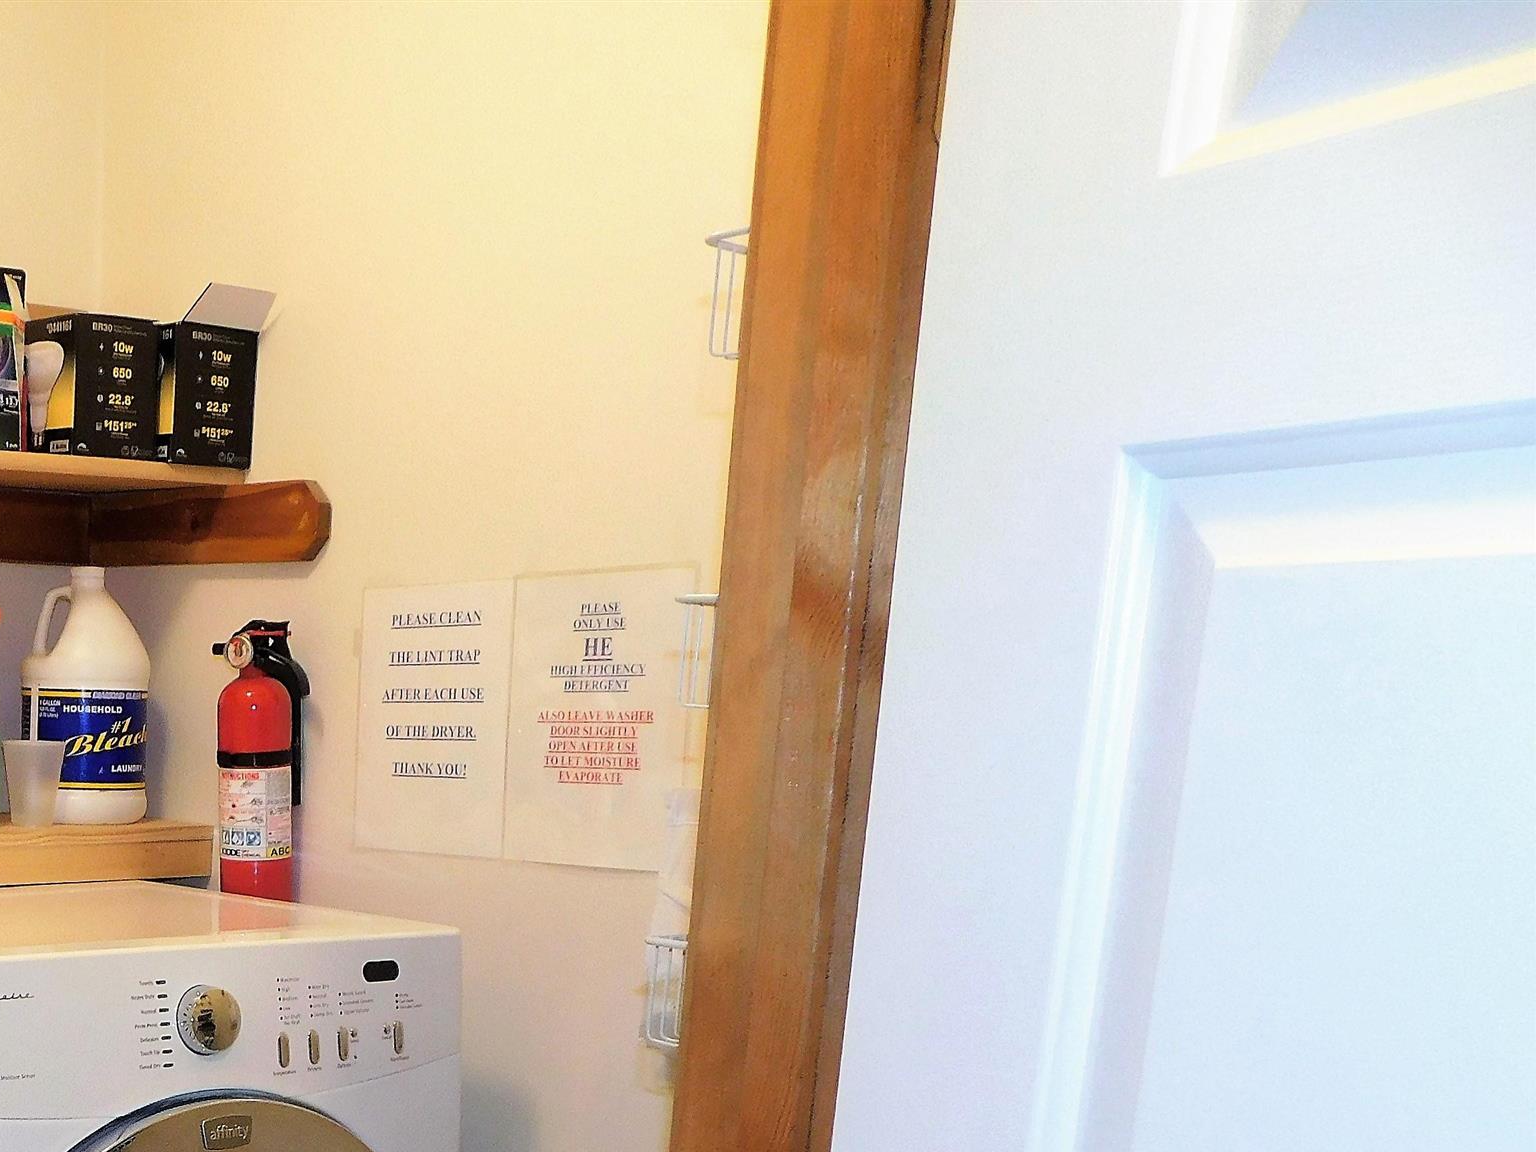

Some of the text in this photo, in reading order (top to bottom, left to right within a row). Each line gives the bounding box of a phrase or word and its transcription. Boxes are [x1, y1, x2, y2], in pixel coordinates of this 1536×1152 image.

[112, 367, 132, 379] 650
[210, 375, 229, 388] 650
[581, 602, 621, 614] PLEASE
[392, 610, 482, 627] PLEASE CLEAN
[573, 617, 627, 629] ONLY USE
[584, 637, 613, 657] HE
[389, 649, 481, 664] THE LINT TRAP
[550, 663, 646, 676] HIGH EFFICIENCY
[564, 679, 629, 691] DETERGENT
[382, 688, 484, 701] AFTER EACH USE
[63, 705, 123, 714] HOUSEHOLD
[538, 710, 654, 721] ALSO LEAVE WASHER
[111, 717, 132, 734] #1
[386, 725, 477, 738] OF THE DRYER.
[550, 725, 638, 736] DOOR SLIGHTLY
[548, 740, 637, 752] OPEN AFTER USE
[544, 755, 641, 768] TO LET MOISTURE
[393, 762, 467, 776] THANK YOU!
[558, 770, 623, 783] EVAPORATE
[270, 846, 290, 857] ABC
[210, 1122, 250, 1142] affinity
